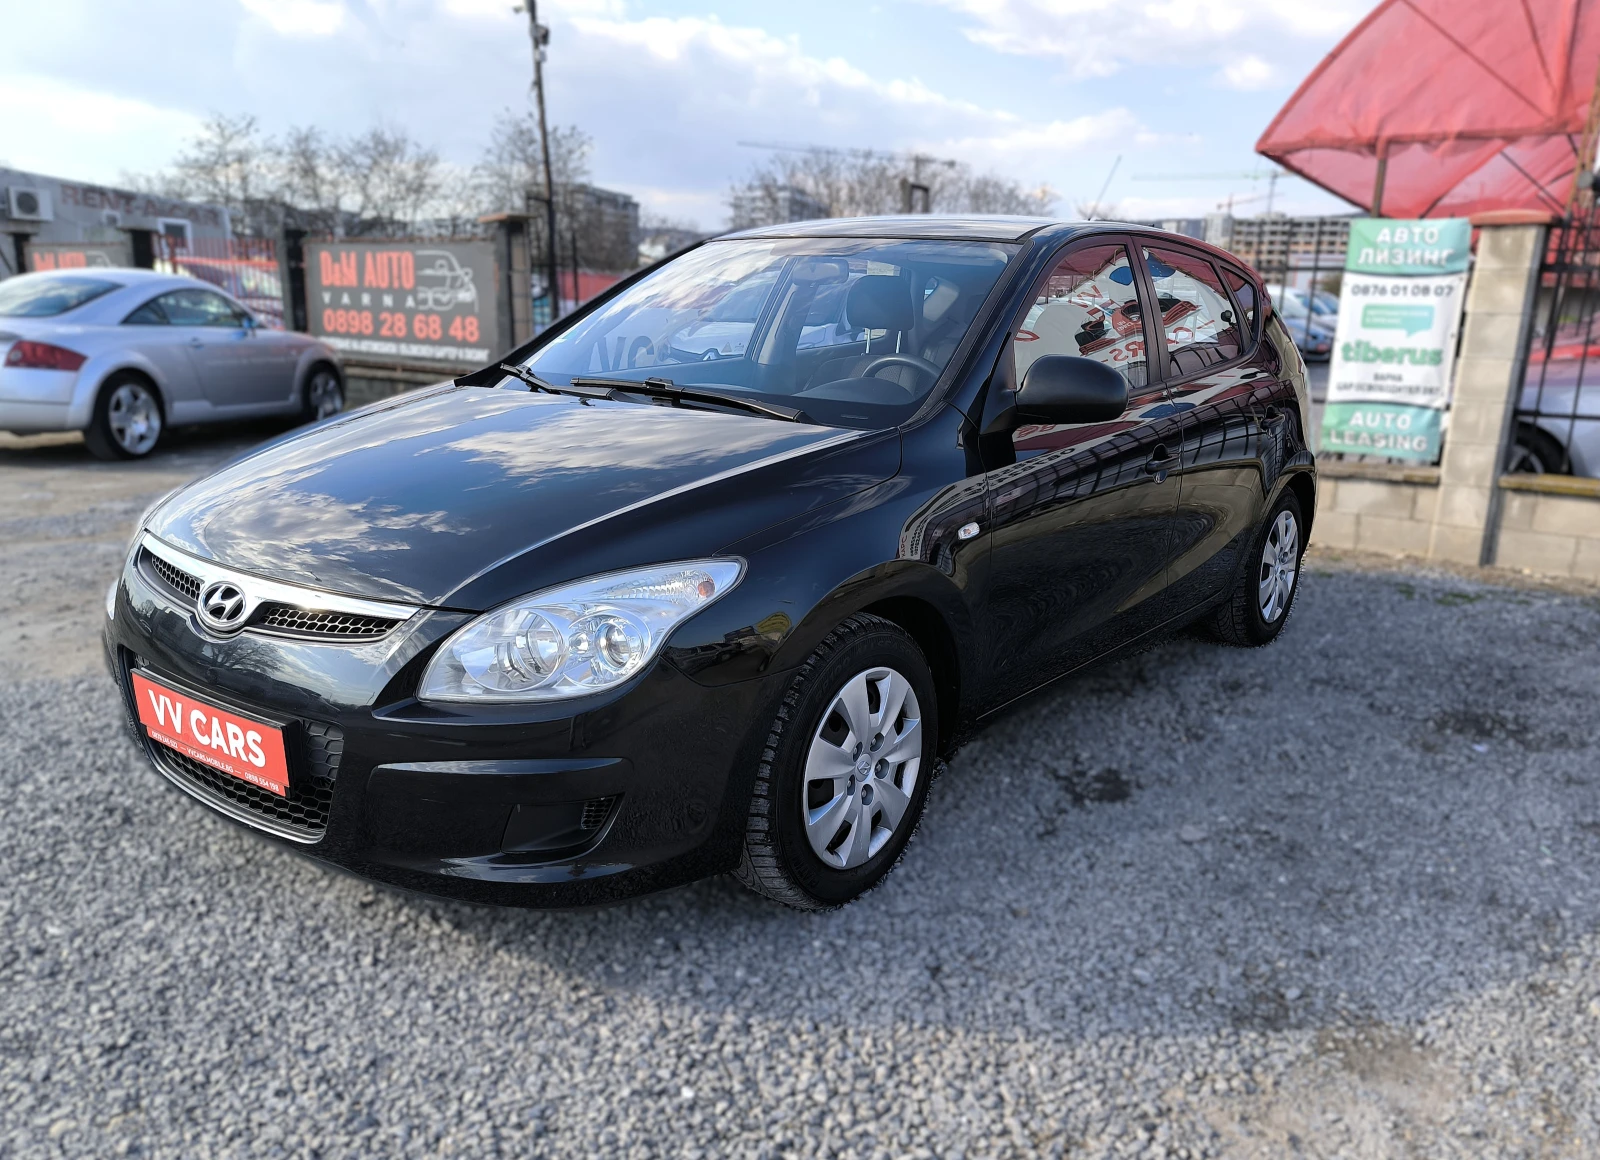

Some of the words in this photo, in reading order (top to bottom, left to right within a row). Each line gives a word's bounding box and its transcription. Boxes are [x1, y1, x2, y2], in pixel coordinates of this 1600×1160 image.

[1376, 226, 1439, 244] АВТО
[1357, 248, 1454, 267] ЛИЗИНГ
[364, 251, 415, 290] AUTO
[322, 291, 416, 309] VARNA
[1391, 284, 1409, 297] 01
[1434, 285, 1454, 298] 07
[323, 309, 374, 335] 0898
[380, 312, 407, 338] 28
[413, 314, 443, 340] 68
[448, 316, 480, 343] 48
[1341, 339, 1443, 366] tiberus
[1351, 411, 1411, 429] AUTO
[1330, 430, 1427, 452] LEASING
[147, 688, 182, 734] VV
[190, 709, 266, 768] CARS
